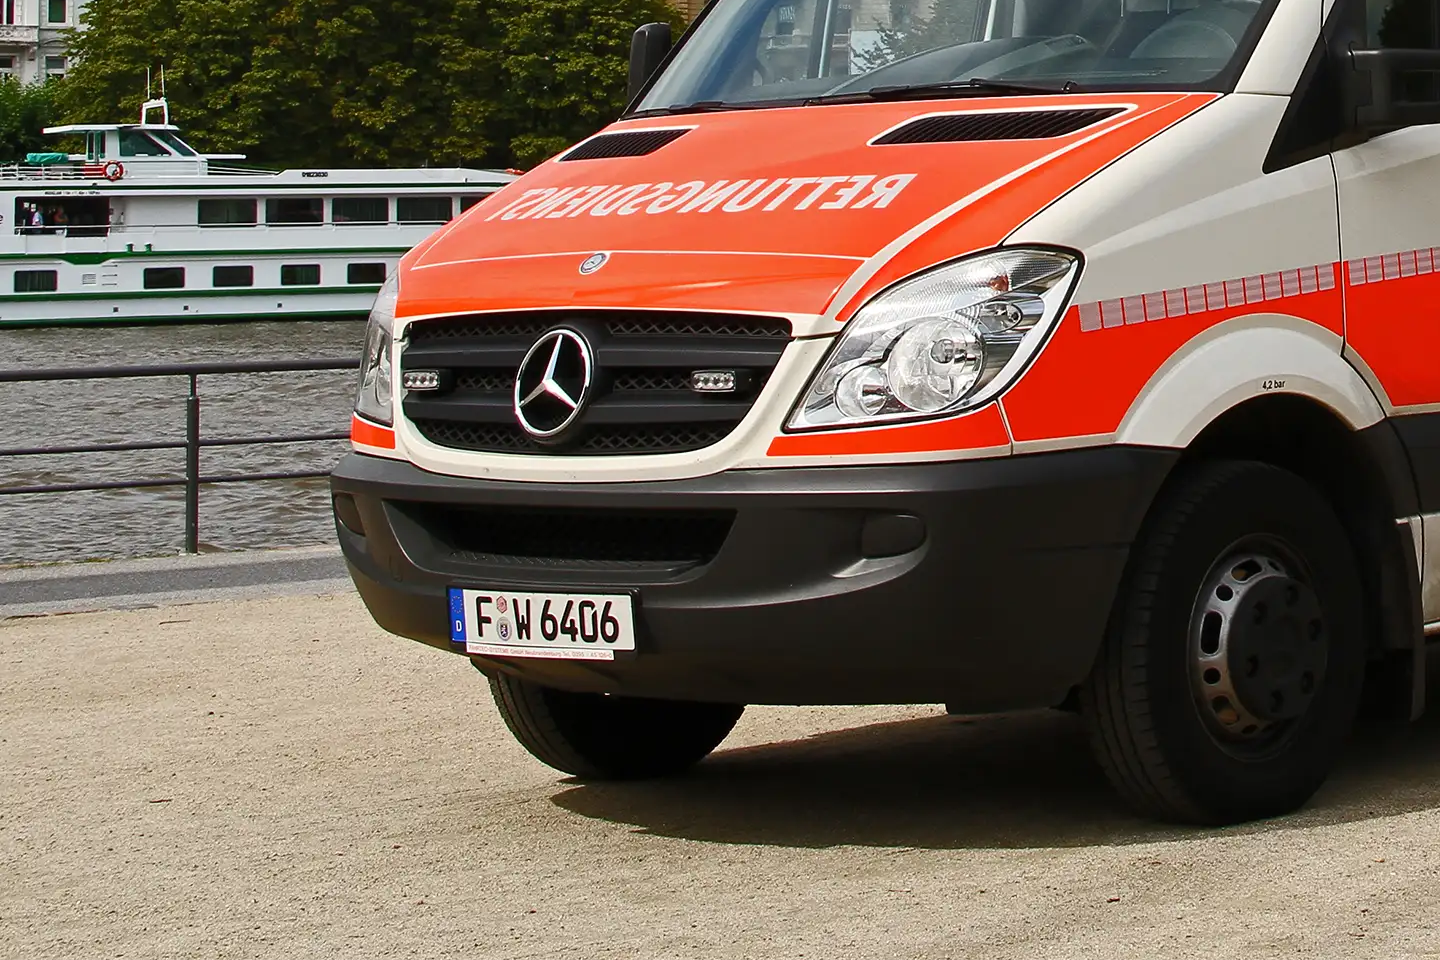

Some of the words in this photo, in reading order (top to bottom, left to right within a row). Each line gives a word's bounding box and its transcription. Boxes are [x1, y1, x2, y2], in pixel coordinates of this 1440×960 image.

[1262, 380, 1273, 390] 4,2
[1274, 380, 1285, 388] bar
[476, 596, 492, 637] F
[512, 598, 531, 640] W
[541, 599, 619, 643] 6406
[456, 620, 462, 632] D
